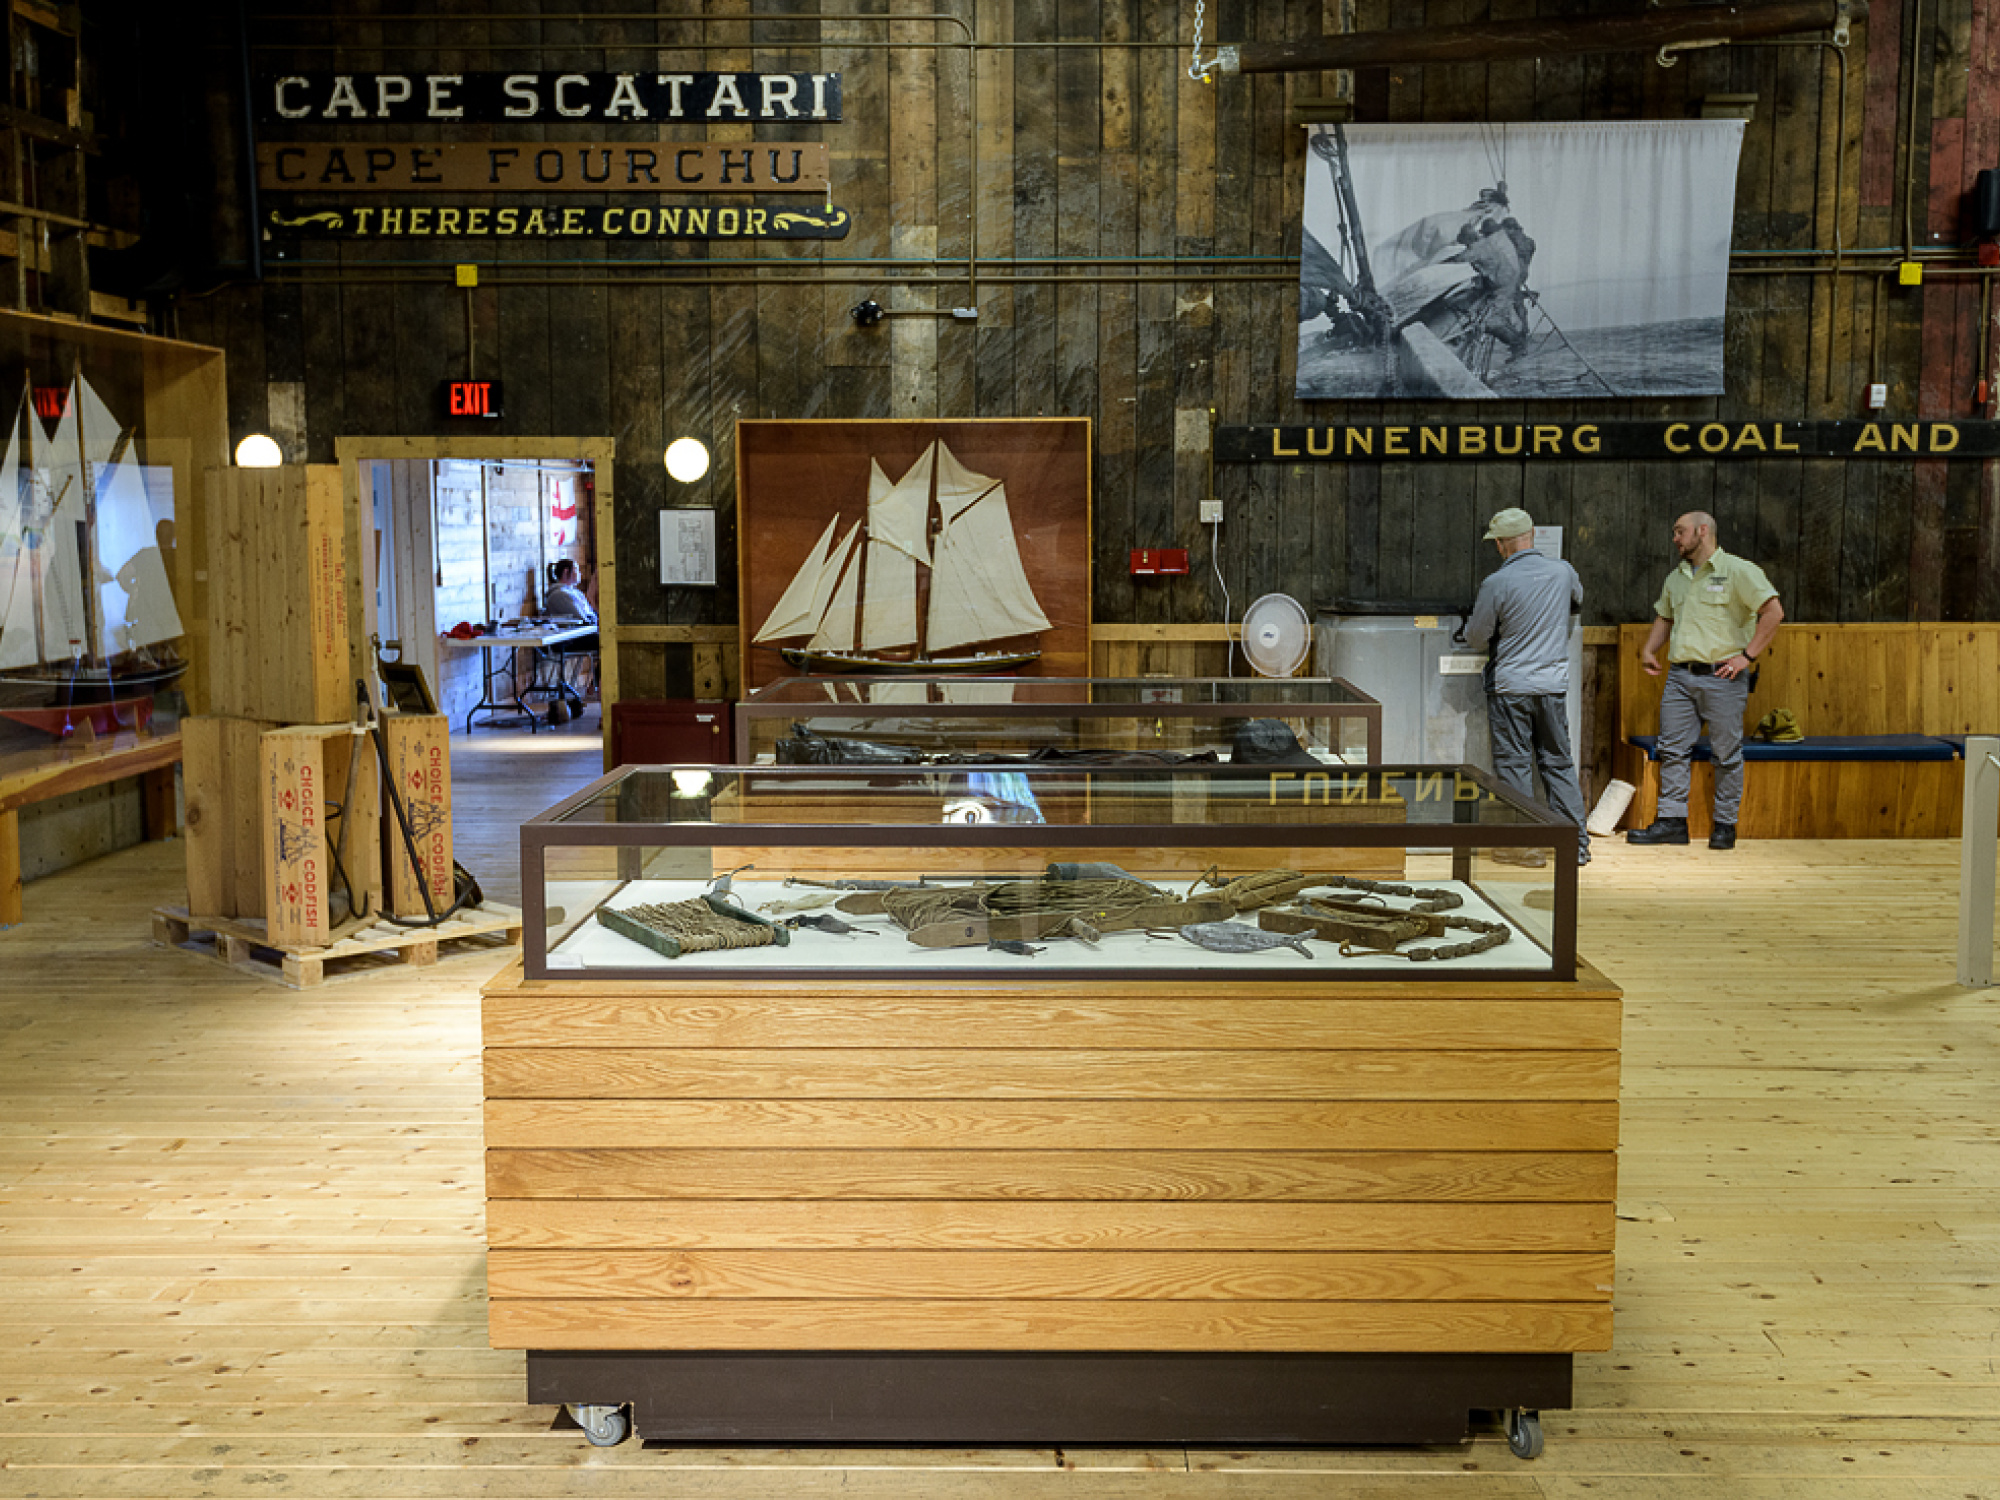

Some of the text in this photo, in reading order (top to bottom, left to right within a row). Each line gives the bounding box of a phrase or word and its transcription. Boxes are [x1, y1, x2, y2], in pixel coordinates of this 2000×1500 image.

[275, 74, 827, 118] CAPE SCATARI
[276, 148, 803, 184] CAPE FOURCHU
[450, 383, 491, 415] EXIT
[1272, 422, 1961, 457] LUNENBURG COAL AND
[429, 745, 447, 897] CHOICE CODFISH
[300, 765, 318, 928] CHOICE CODFISH
